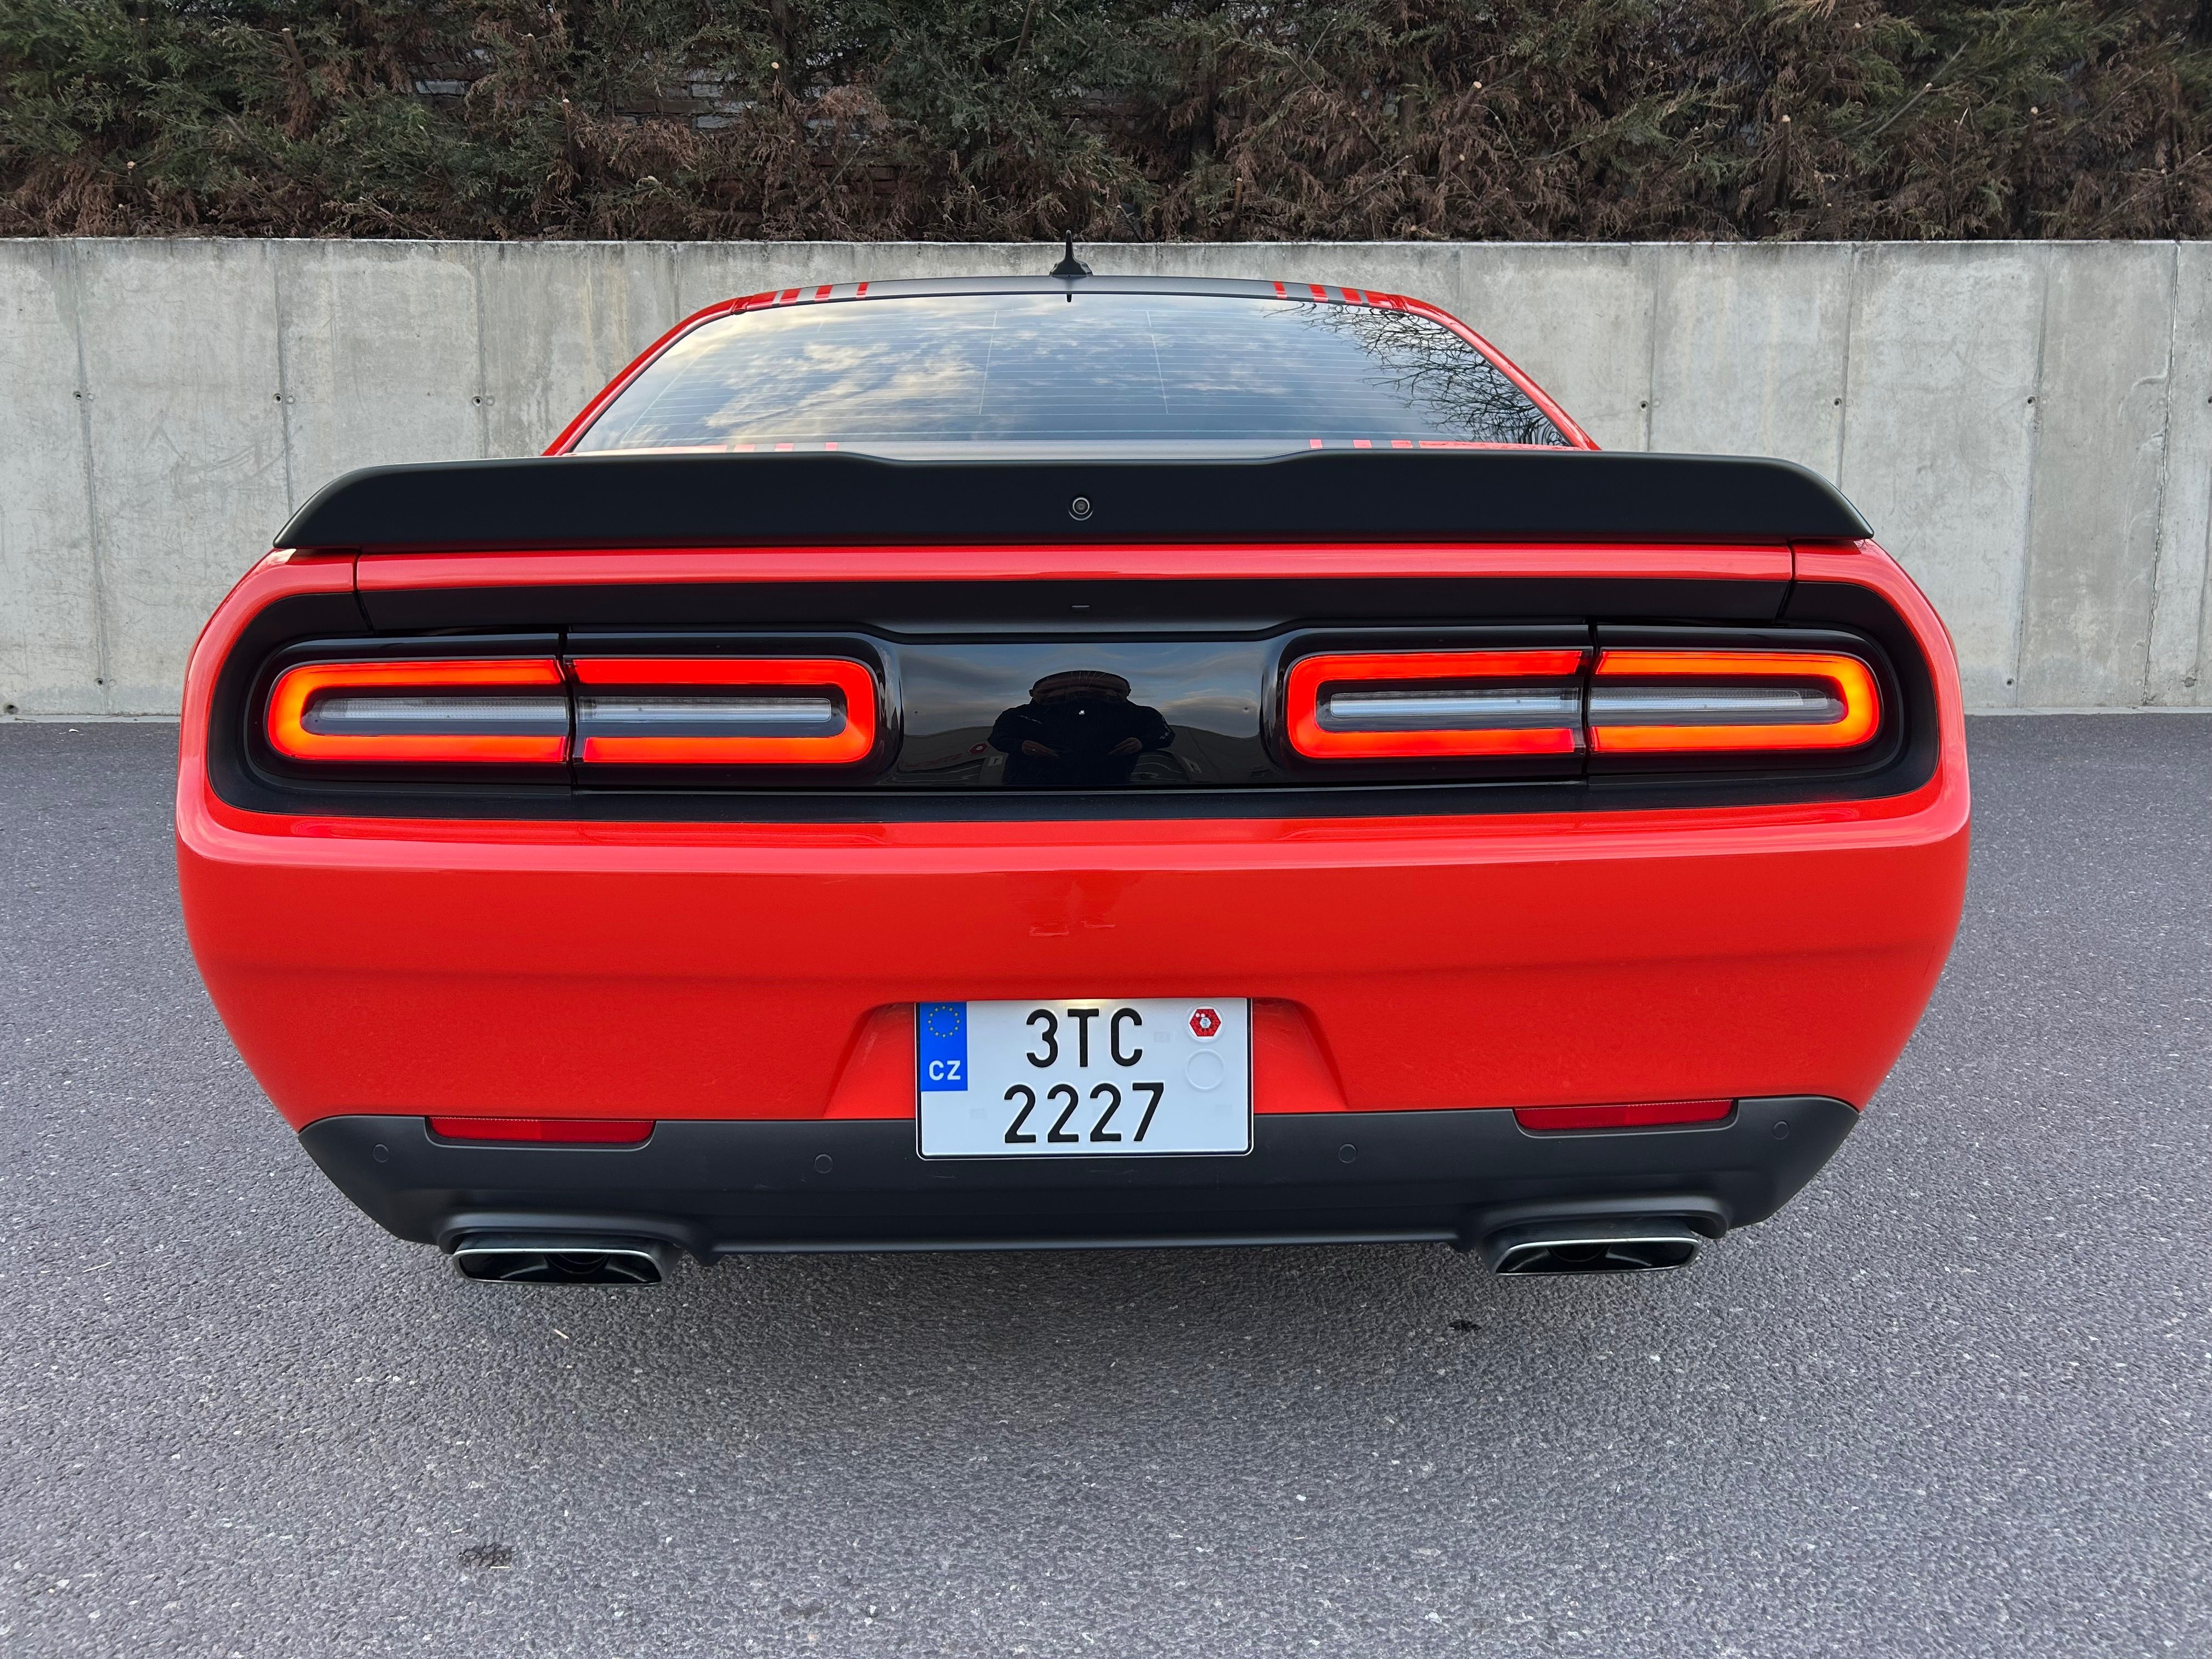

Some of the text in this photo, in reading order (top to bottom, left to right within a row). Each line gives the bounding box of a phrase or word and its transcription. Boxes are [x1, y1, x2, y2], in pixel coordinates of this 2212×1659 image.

[1025, 1007, 1143, 1069] 3TC
[928, 1060, 961, 1081] CZ
[1003, 1082, 1165, 1144] 2227
